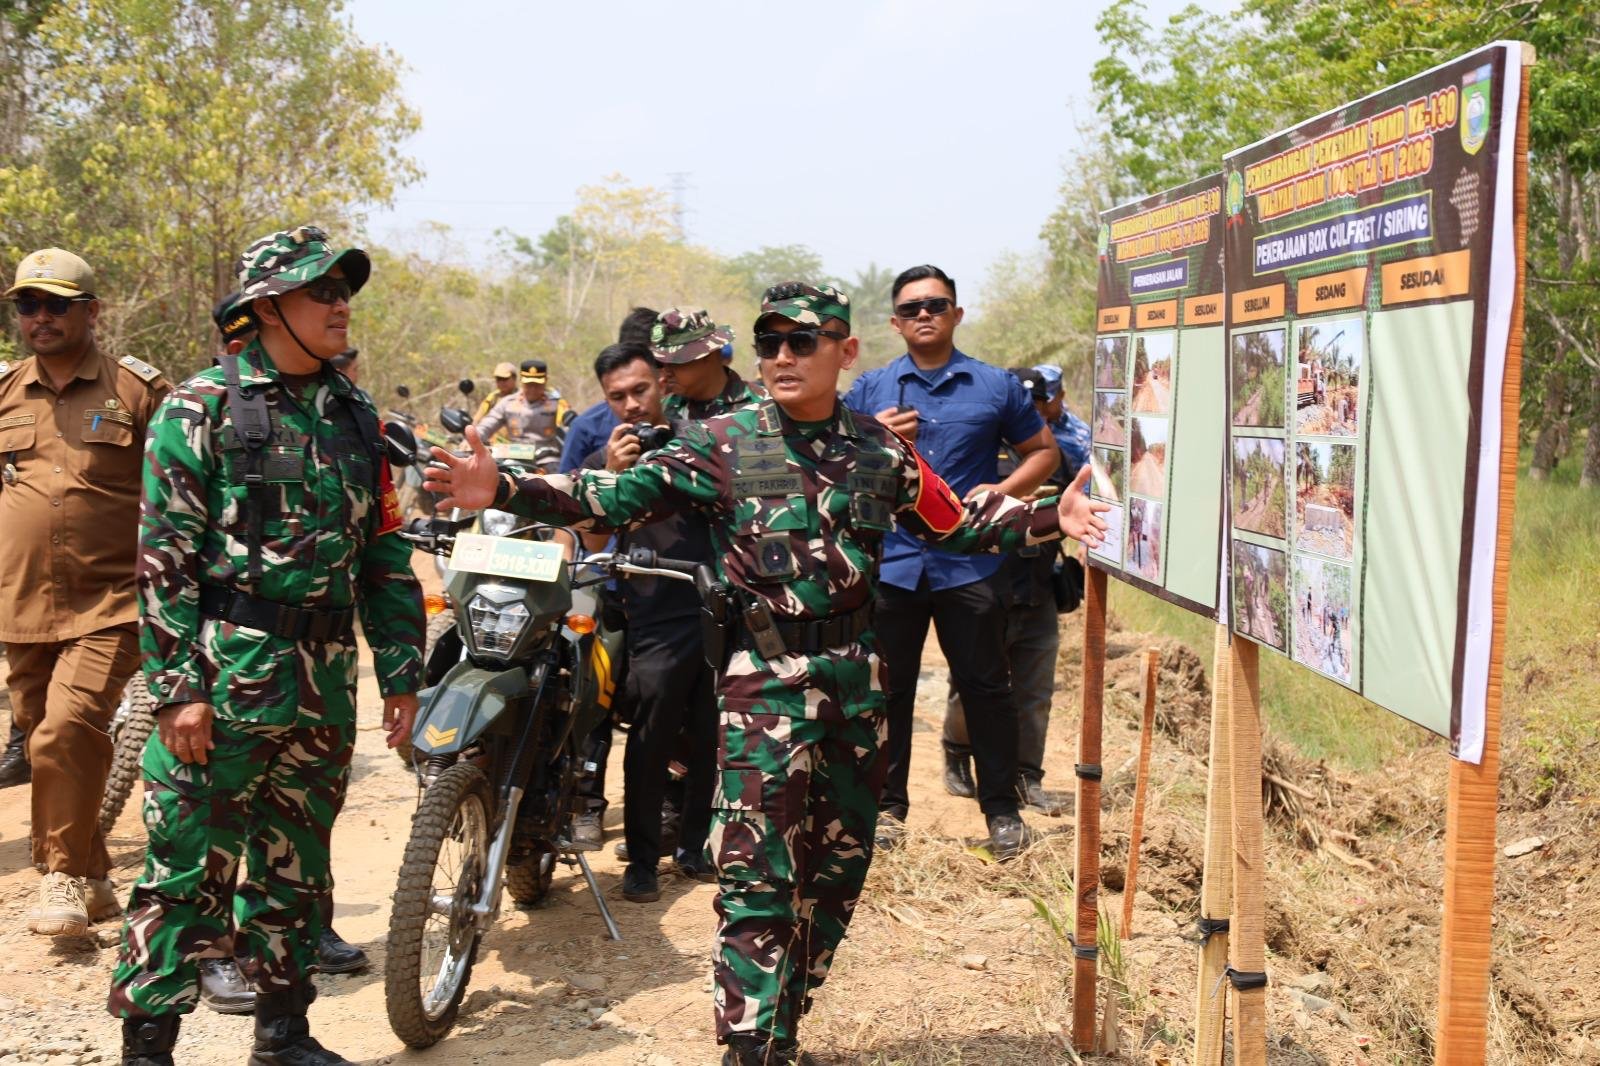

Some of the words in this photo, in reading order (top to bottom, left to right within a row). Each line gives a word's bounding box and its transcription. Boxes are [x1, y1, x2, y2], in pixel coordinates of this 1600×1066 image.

[1407, 87, 1457, 138] KE-130
[1396, 135, 1433, 180] 2026
[1256, 234, 1307, 266] PEKERJAAN
[1308, 228, 1328, 254] BOX
[1330, 216, 1376, 249] CULFRET
[1377, 213, 1383, 239] /
[1384, 203, 1428, 237] SIRING
[1315, 283, 1346, 301] SEDANG
